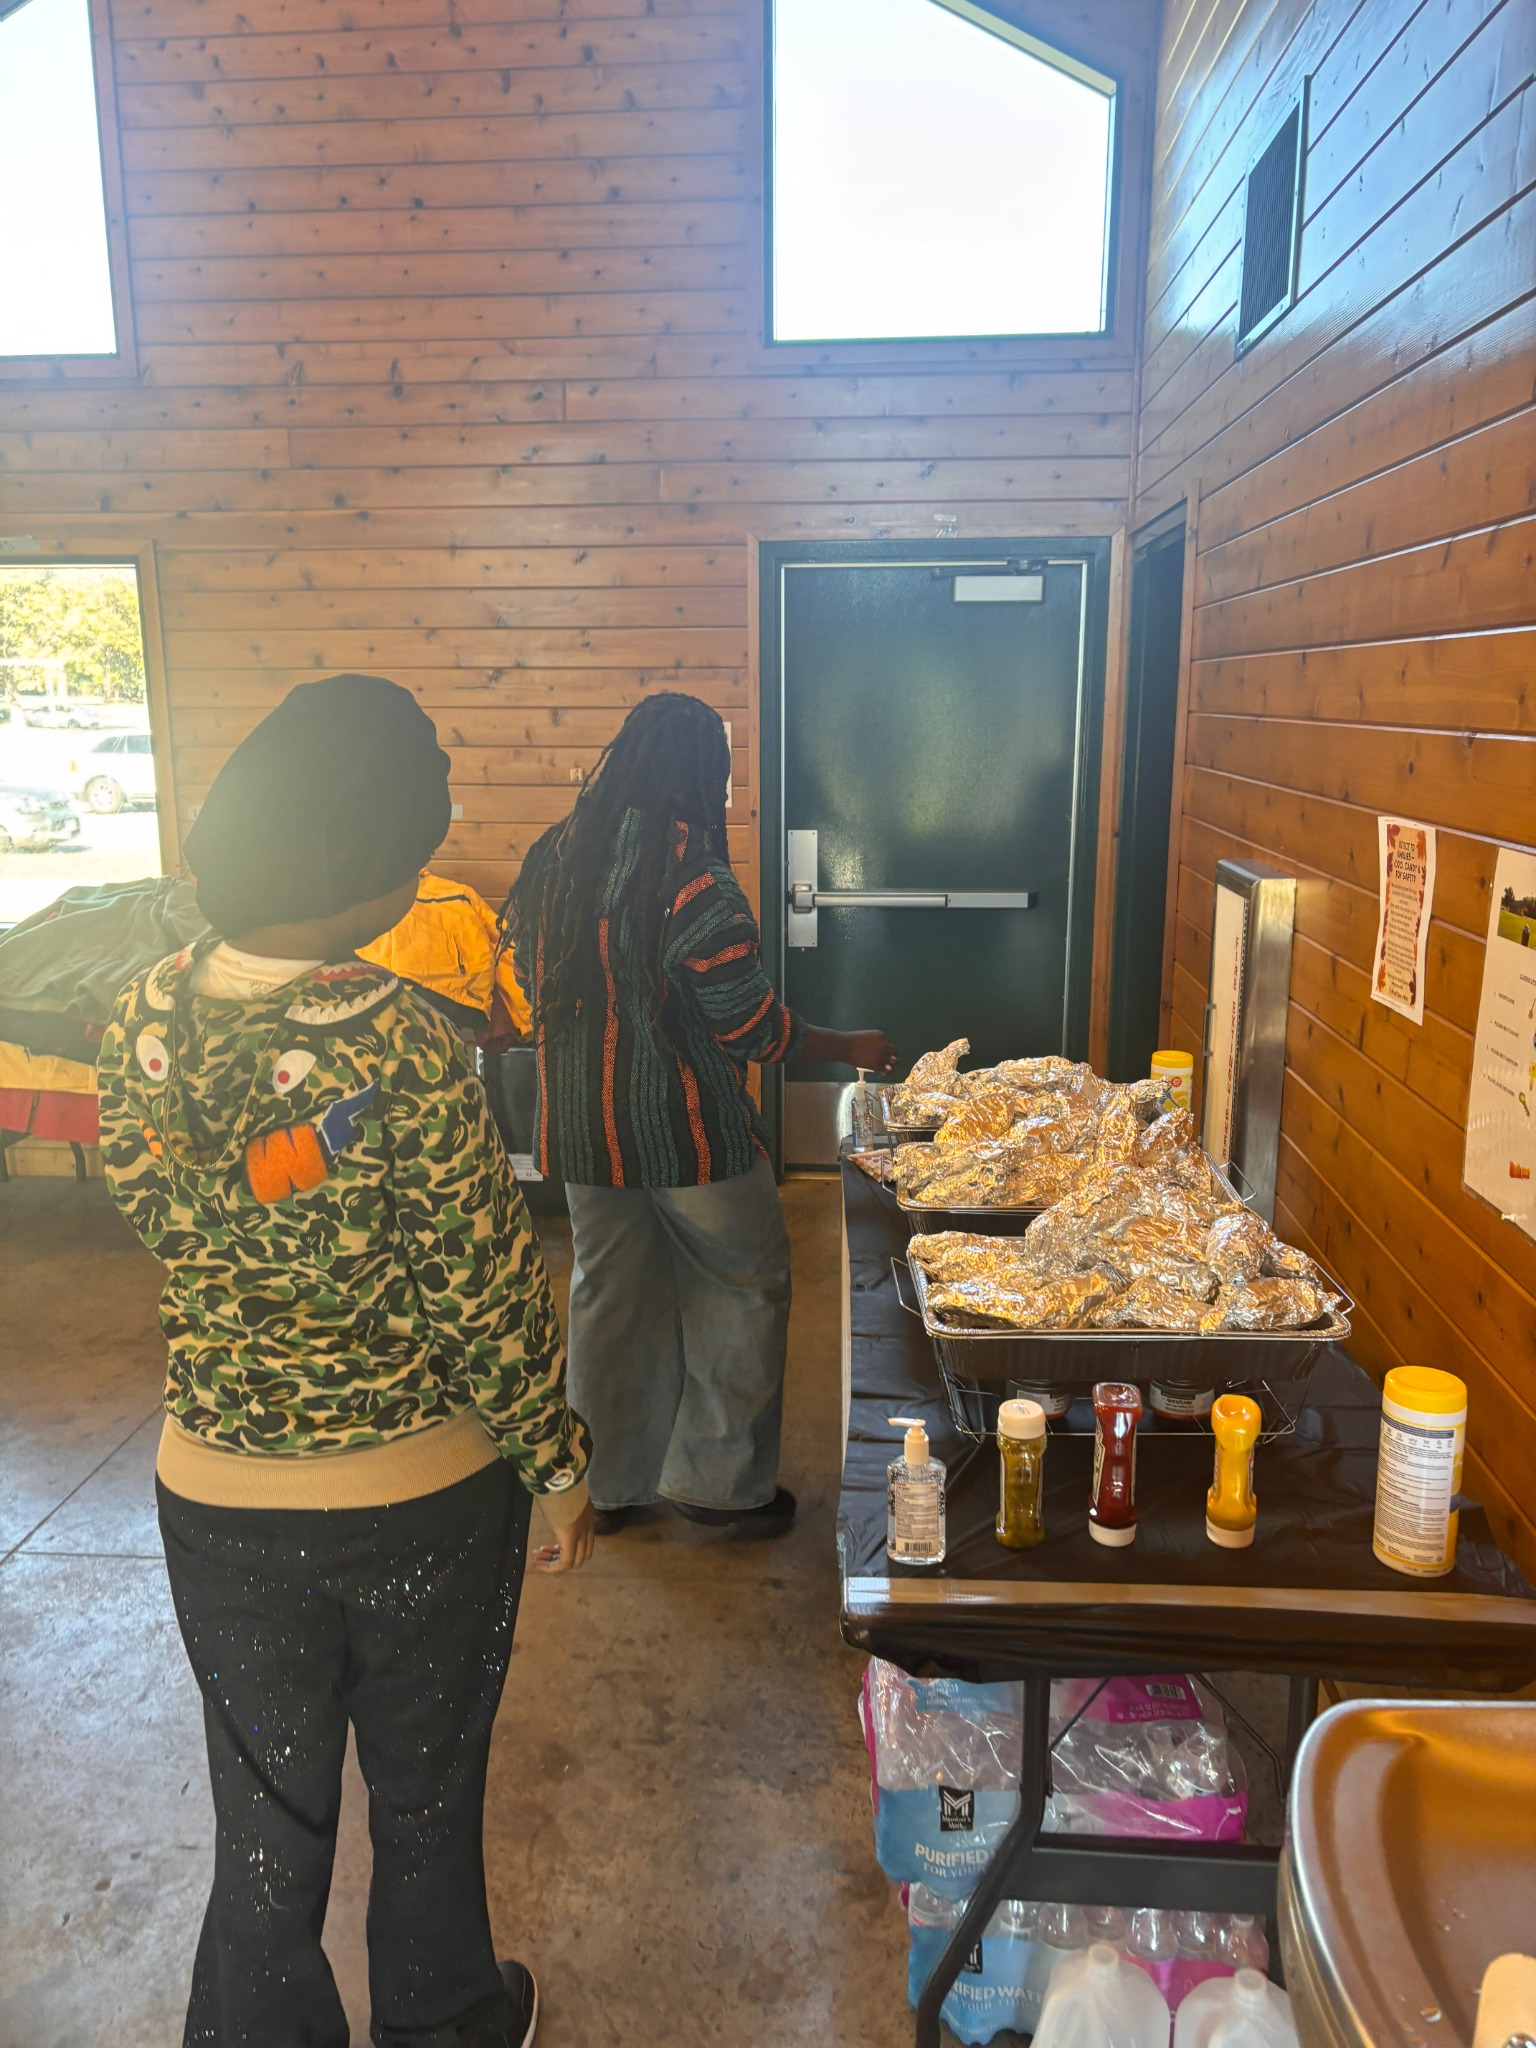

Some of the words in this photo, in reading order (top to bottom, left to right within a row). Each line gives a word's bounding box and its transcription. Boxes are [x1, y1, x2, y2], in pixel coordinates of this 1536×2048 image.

[1403, 872, 1416, 883] SAFETY
[949, 1821, 965, 1830] Mark
[914, 1842, 989, 1867] PURIFIED
[923, 1861, 947, 1878] FOR
